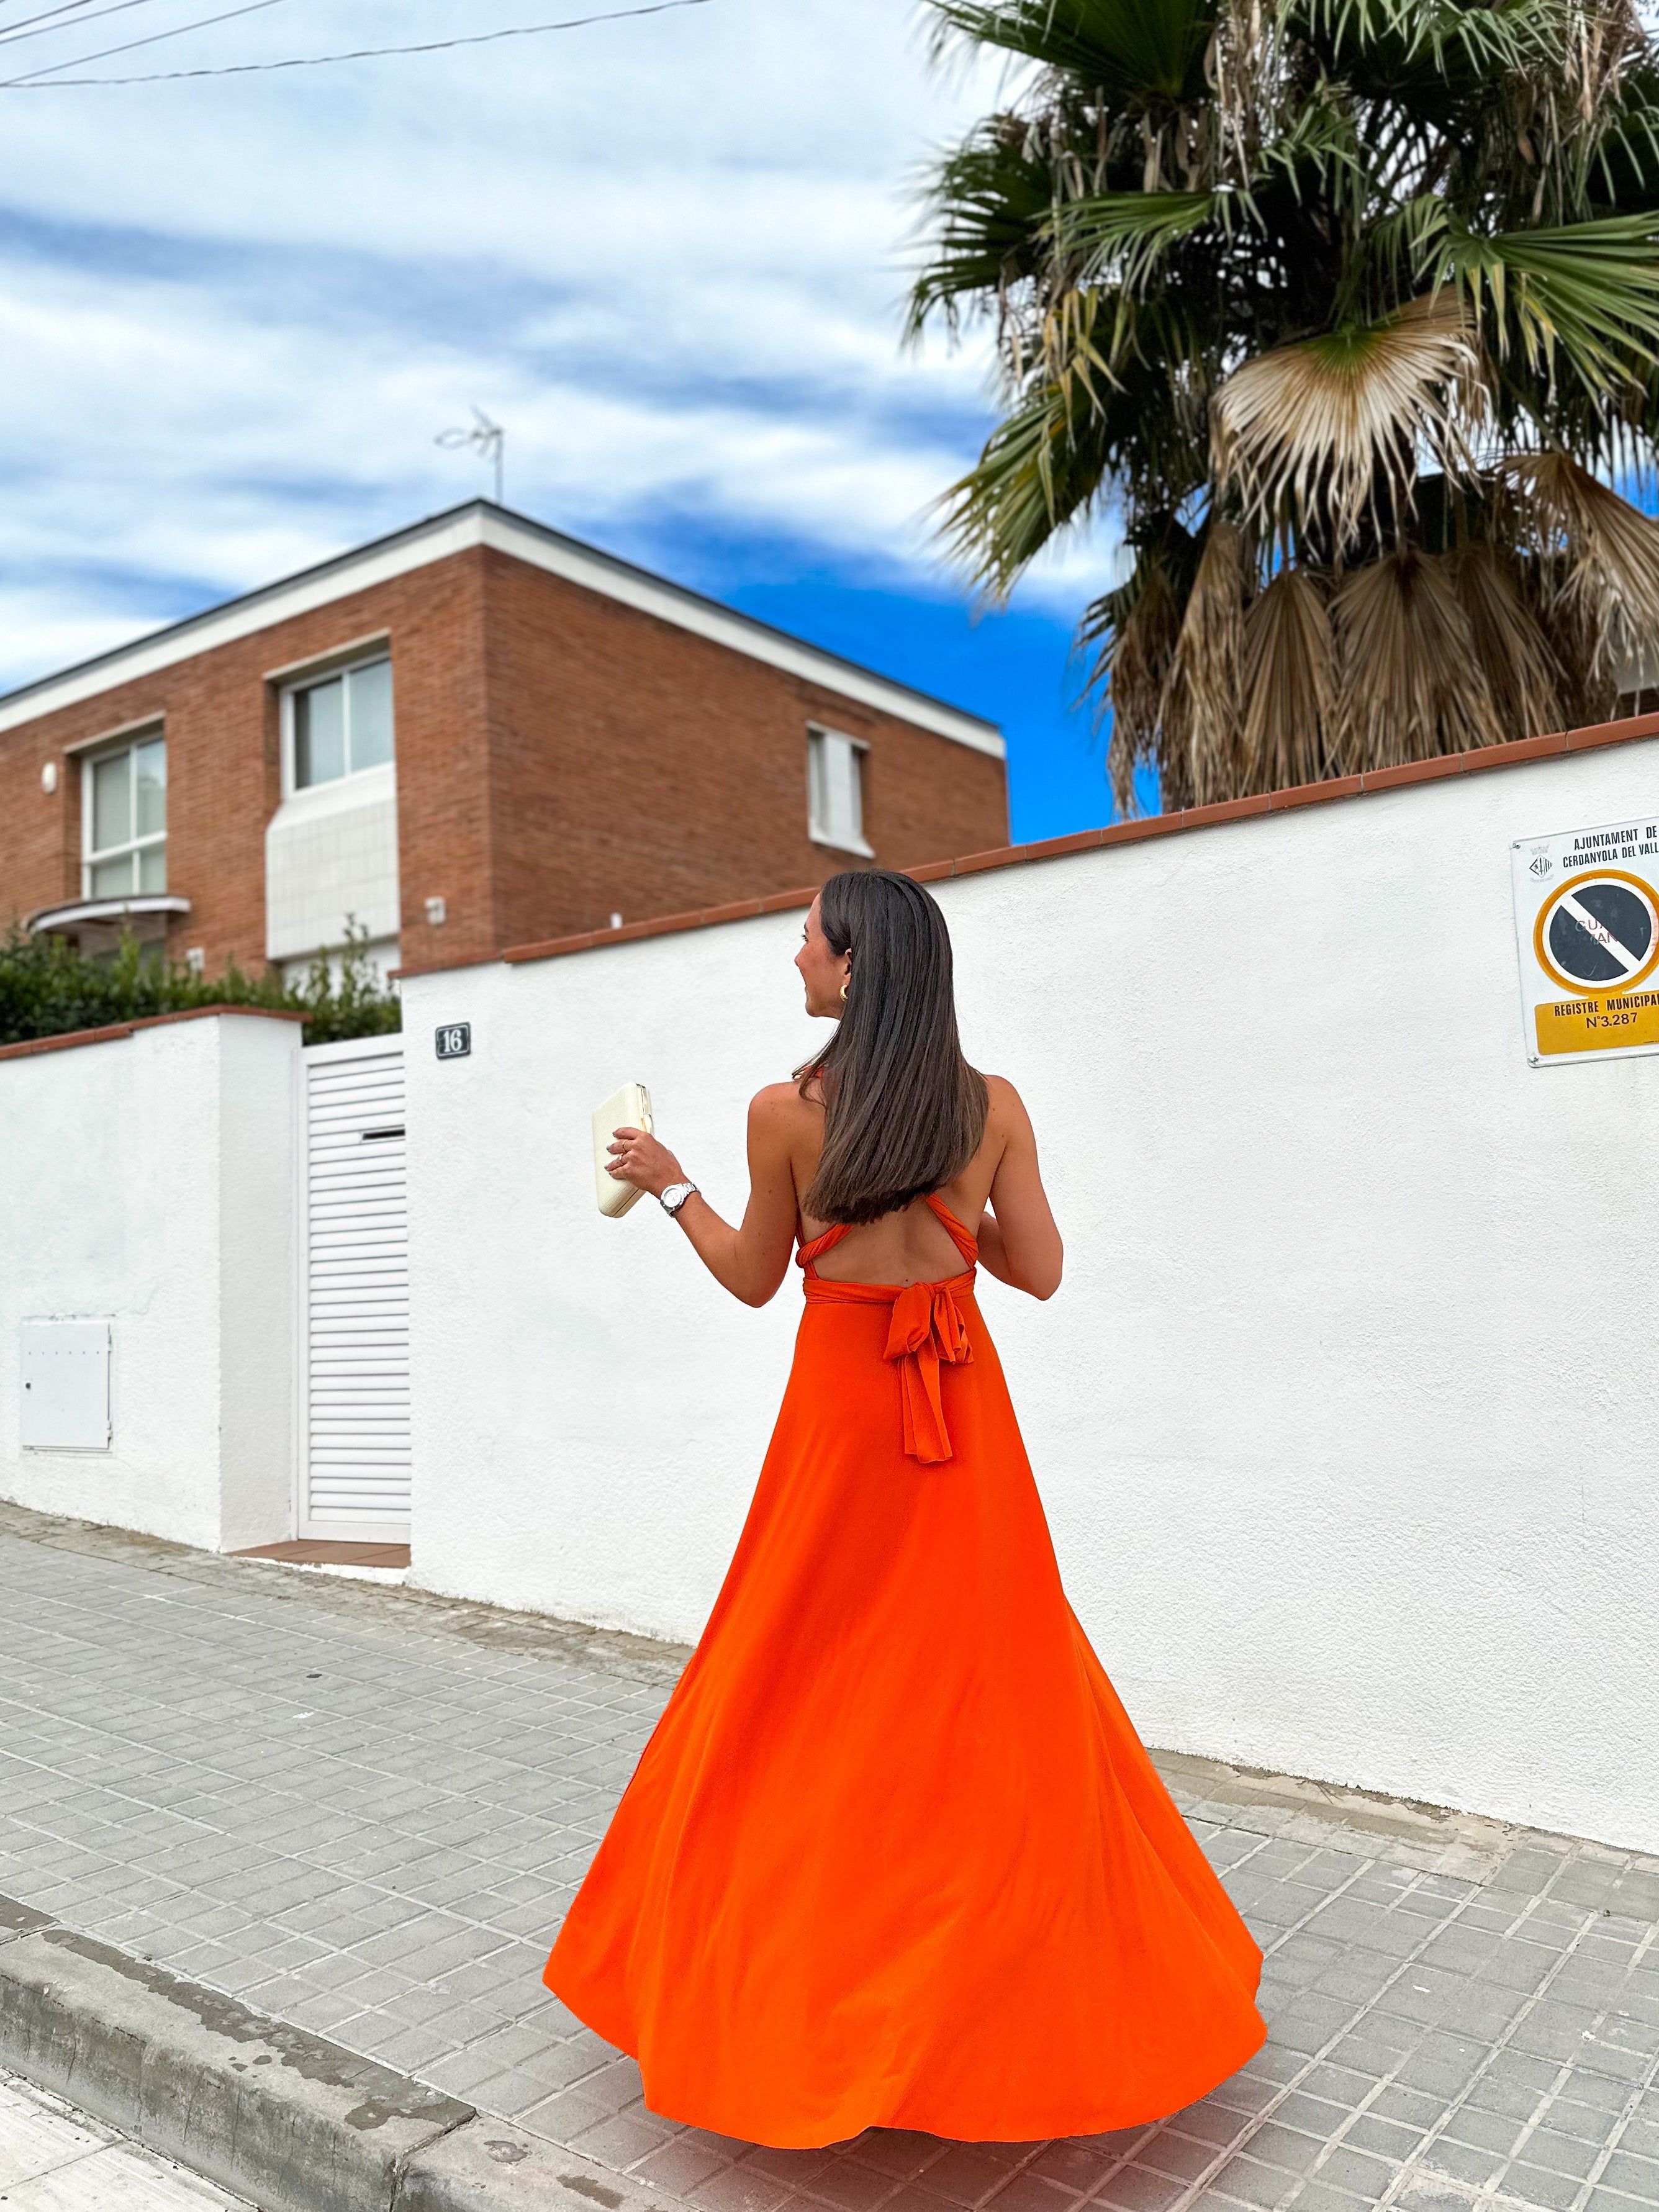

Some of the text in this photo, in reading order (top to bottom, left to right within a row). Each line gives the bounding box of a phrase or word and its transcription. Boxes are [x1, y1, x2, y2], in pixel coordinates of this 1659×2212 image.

[1574, 826, 1657, 851] AJUNTAMENT DE
[1563, 848, 1618, 867] CERDANYOLA
[1622, 846, 1636, 858] DEL
[1554, 1001, 1599, 1016] REGISTRE
[443, 1029, 461, 1052] 16
